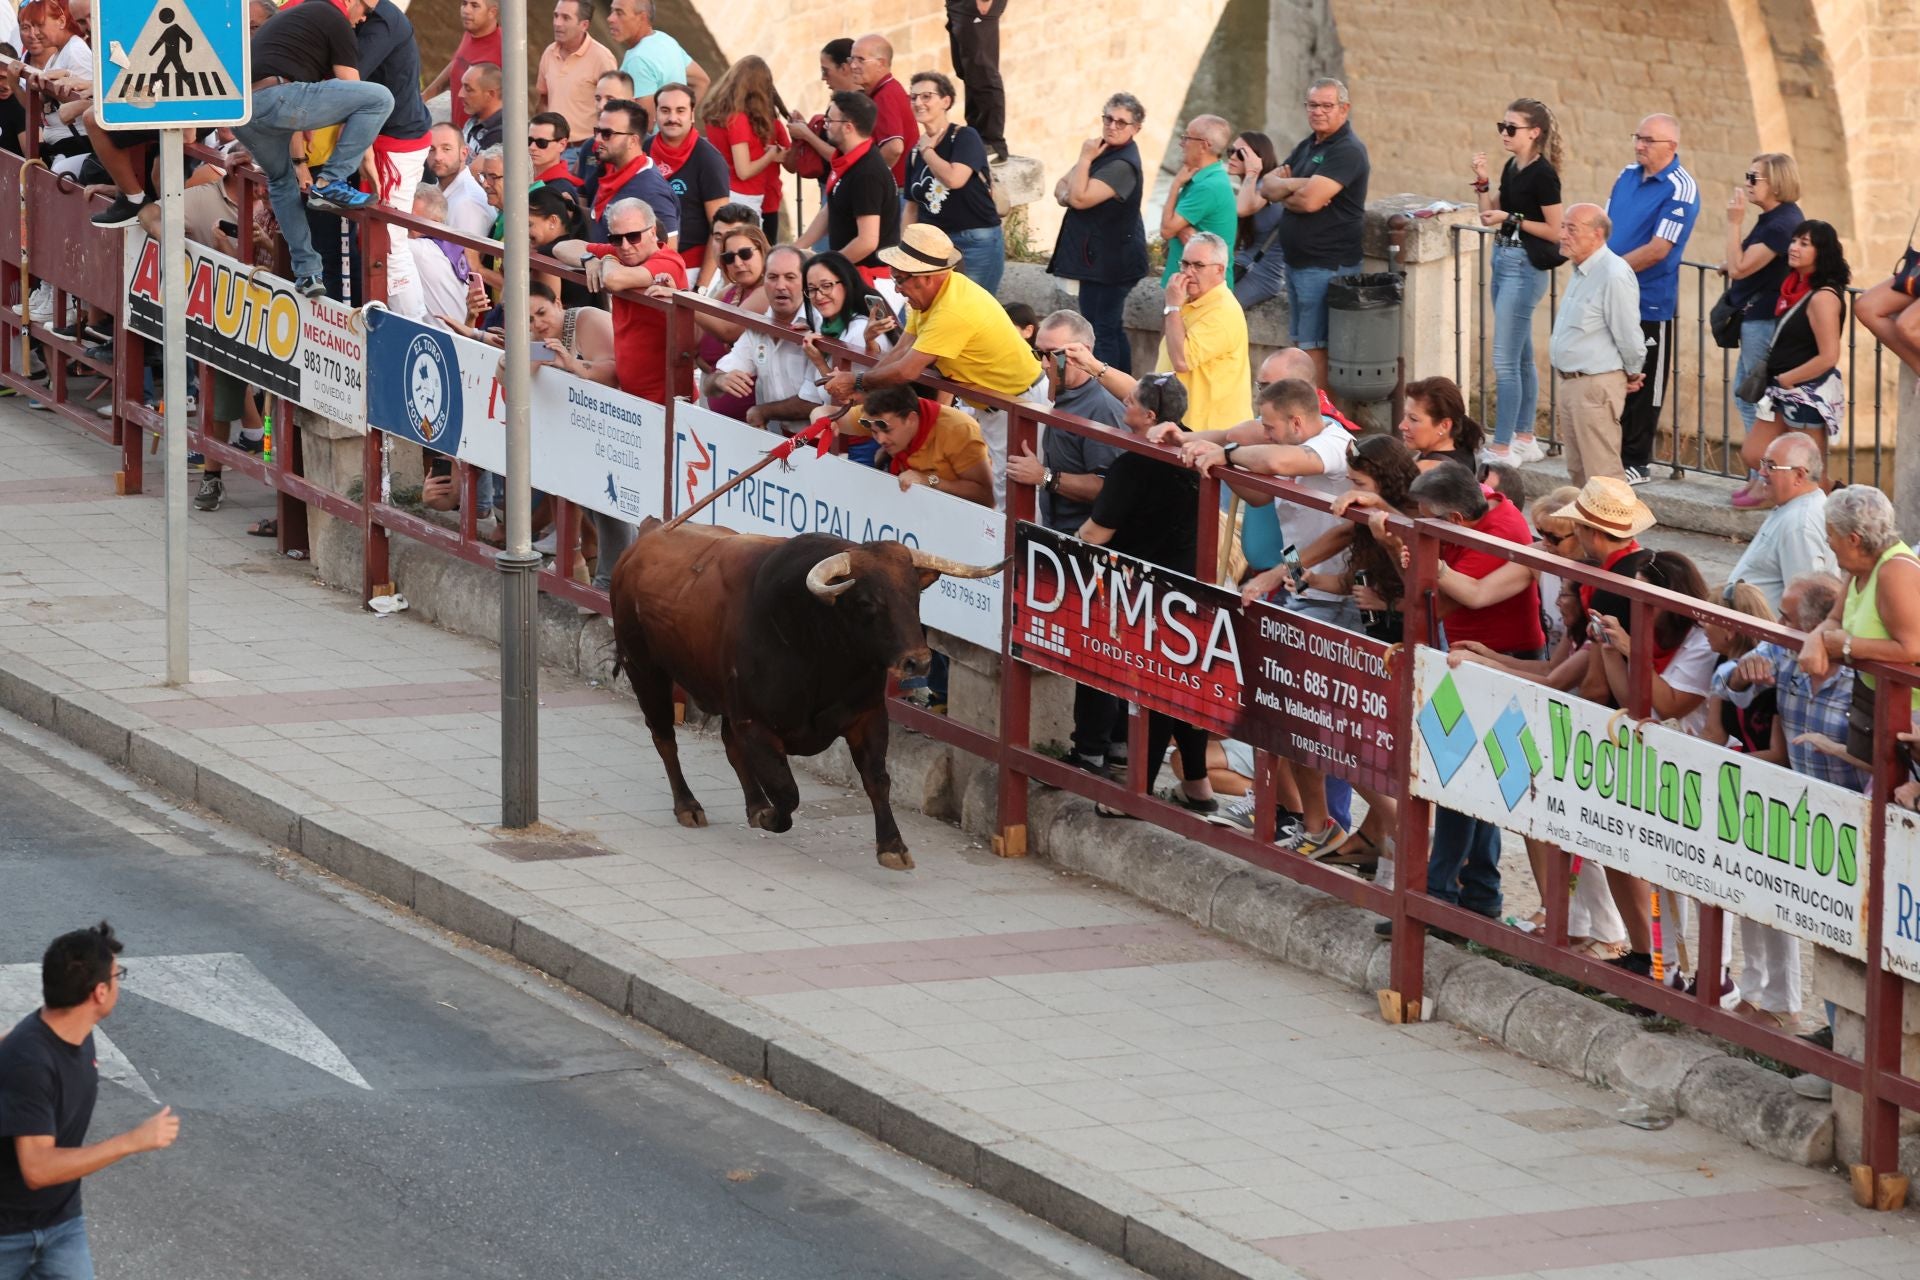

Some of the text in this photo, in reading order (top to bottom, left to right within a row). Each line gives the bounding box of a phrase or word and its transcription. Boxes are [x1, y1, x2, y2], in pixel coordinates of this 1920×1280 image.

[303, 322, 361, 361] MECÁNICO
[414, 339, 441, 363] EL TORO
[304, 349, 361, 391] 983 770 384
[313, 398, 352, 424] TORDESILLAS
[569, 386, 642, 426] Dulces artesanos
[570, 409, 642, 449] desde el corazón
[595, 439, 605, 457] de
[620, 490, 640, 504] DULCES
[727, 468, 807, 533] PRIETO
[940, 579, 957, 599] 983
[959, 586, 974, 606] 796
[976, 593, 991, 612] 331
[1026, 540, 1245, 685] DYMSA
[1260, 617, 1306, 651] EMPRESA
[1081, 634, 1201, 690] TORDESILLAS
[1255, 688, 1282, 711] Avda.
[1285, 697, 1334, 731] Valladolid,
[1350, 721, 1362, 740] 14
[1304, 669, 1328, 699] 685
[1332, 679, 1358, 709] 779
[1362, 690, 1387, 720] 506
[1290, 732, 1358, 769] TORDESILLAS
[1548, 698, 1858, 887] Vecillas Santos
[1618, 847, 1629, 863] 16
[1626, 822, 1636, 840] Y
[1639, 827, 1705, 864] SERVICIOS
[1713, 854, 1723, 870] A
[1726, 857, 1742, 879] LA
[1745, 865, 1854, 921] CONSTRUCCION
